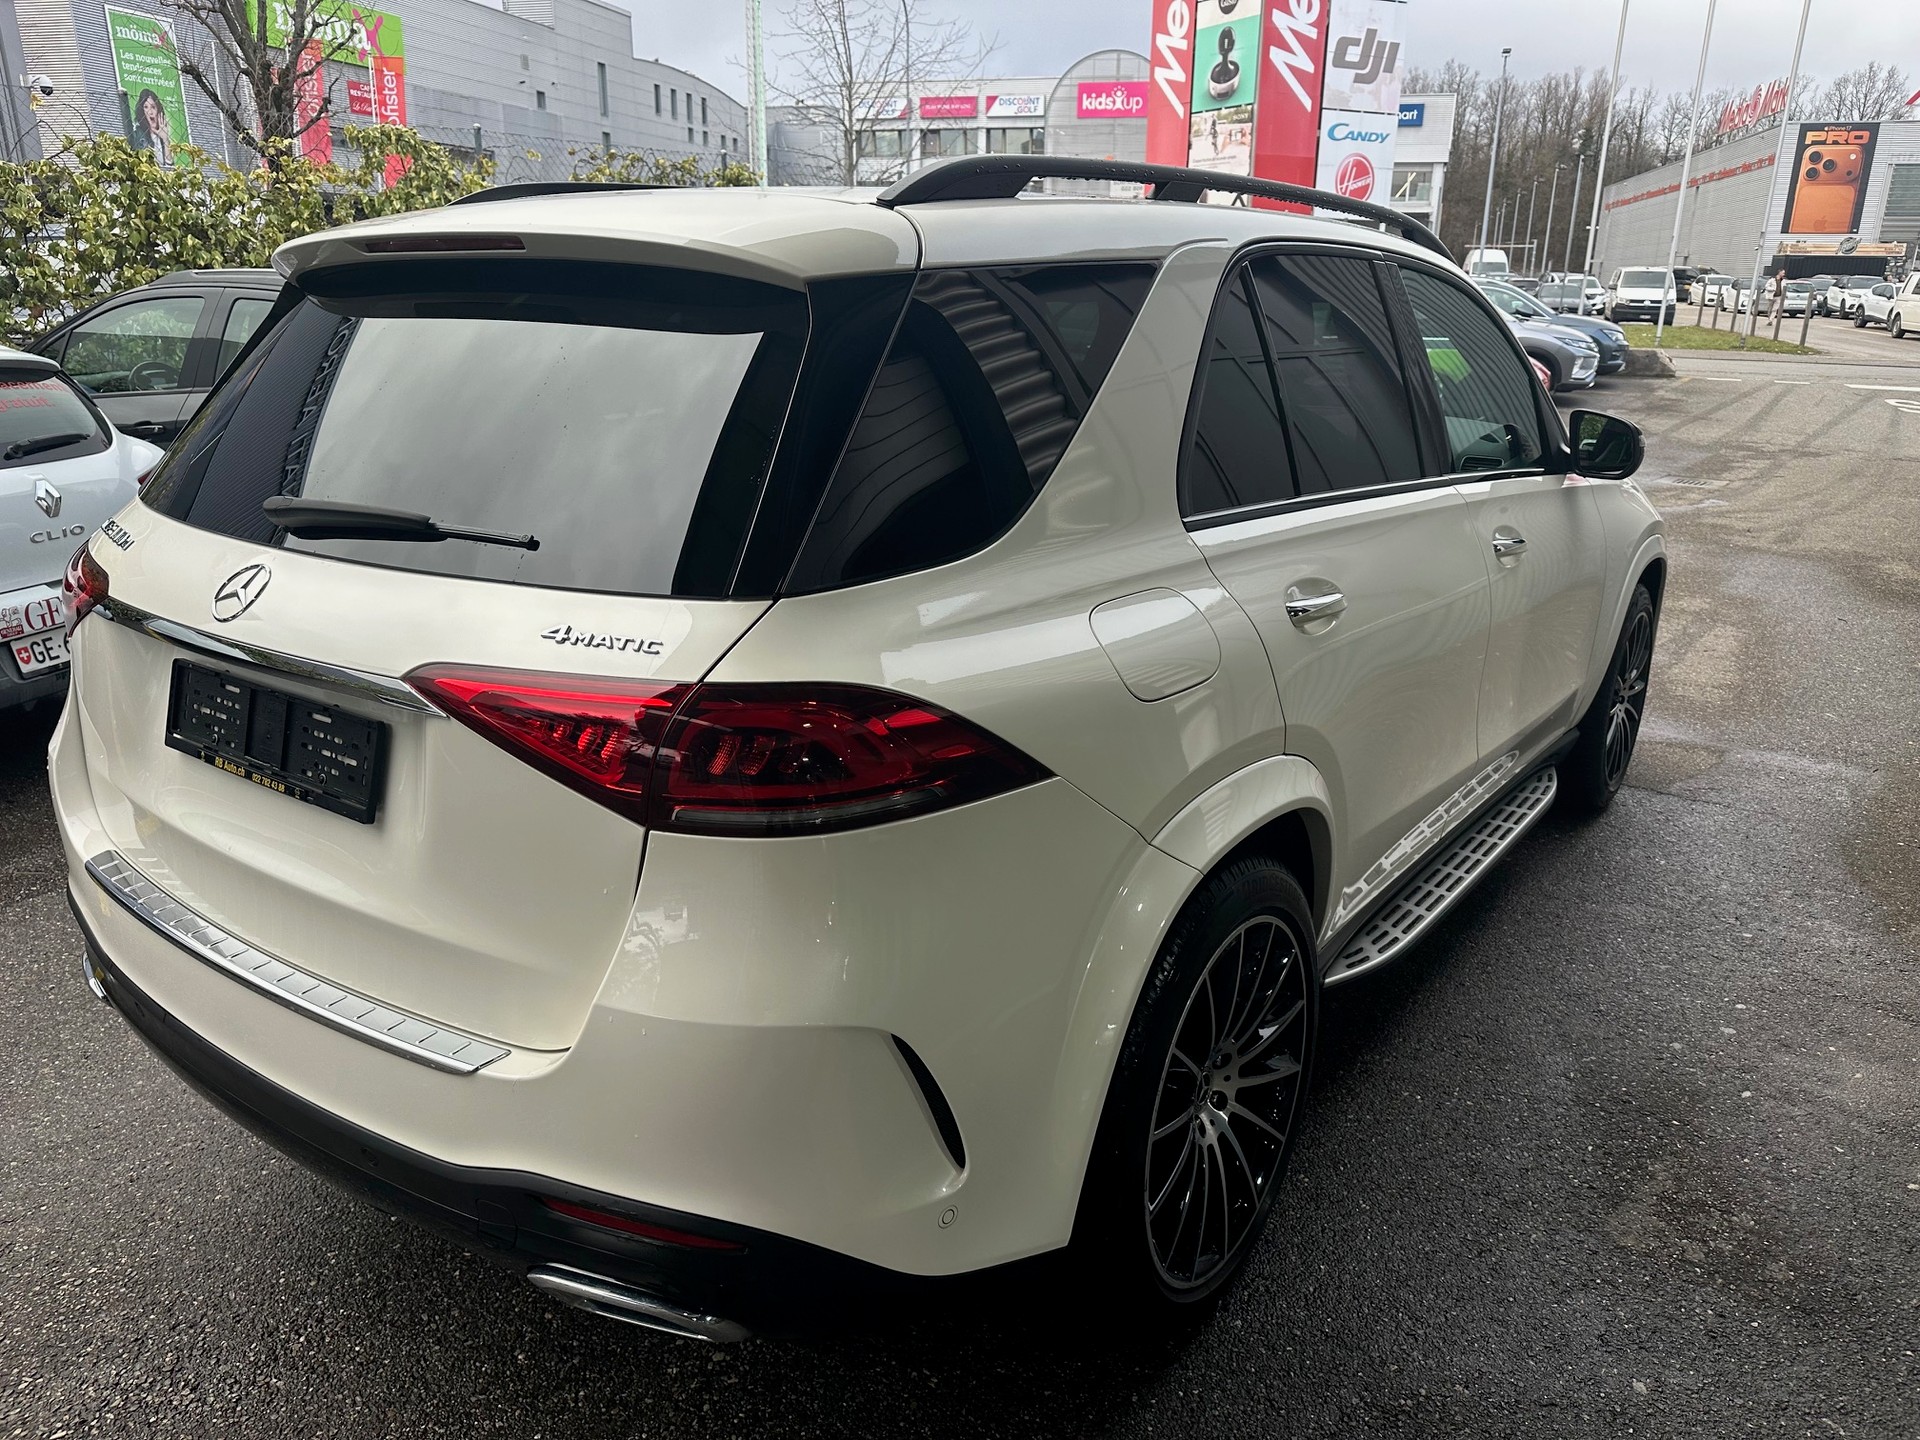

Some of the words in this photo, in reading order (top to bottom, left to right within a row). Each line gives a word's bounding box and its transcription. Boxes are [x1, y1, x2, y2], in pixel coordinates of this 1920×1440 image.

[120, 49, 134, 60] Les
[999, 96, 1040, 106] DISCOUNT
[1016, 106, 1038, 114] GOLF
[1804, 131, 1871, 145] PRO
[29, 523, 86, 545] CLIO
[540, 623, 664, 655] 4MATIC
[223, 760, 245, 777] Auto.ch
[252, 772, 262, 784] 022
